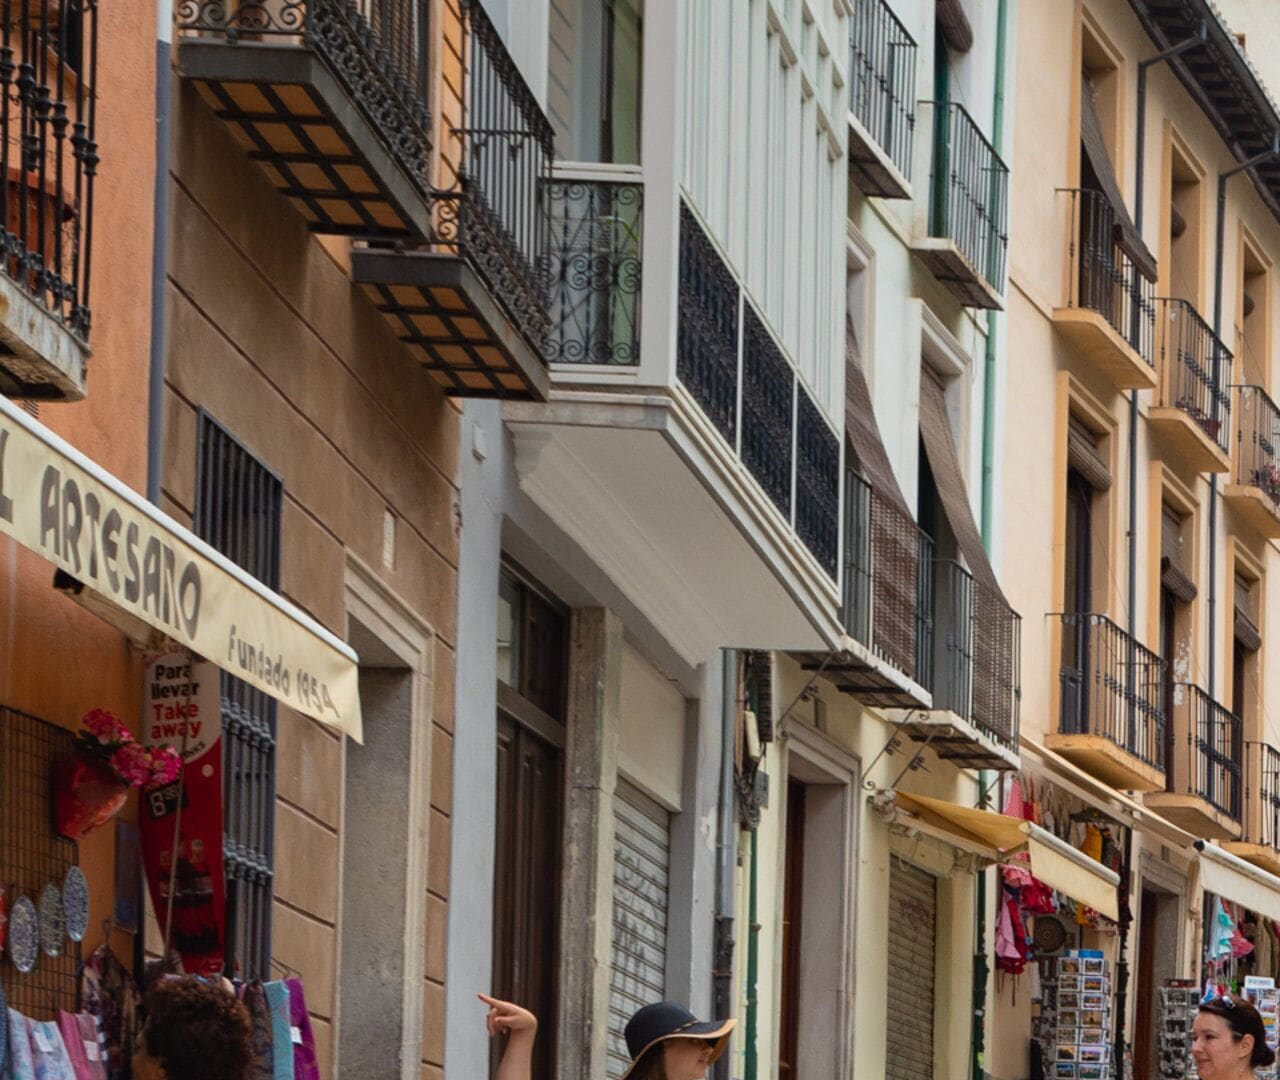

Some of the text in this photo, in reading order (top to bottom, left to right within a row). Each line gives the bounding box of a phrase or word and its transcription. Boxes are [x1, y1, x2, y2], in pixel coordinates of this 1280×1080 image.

[40, 464, 203, 642] ARTESANO
[154, 663, 192, 679] Para
[150, 681, 200, 699] llevar
[152, 702, 199, 721] Take
[150, 721, 202, 739] away
